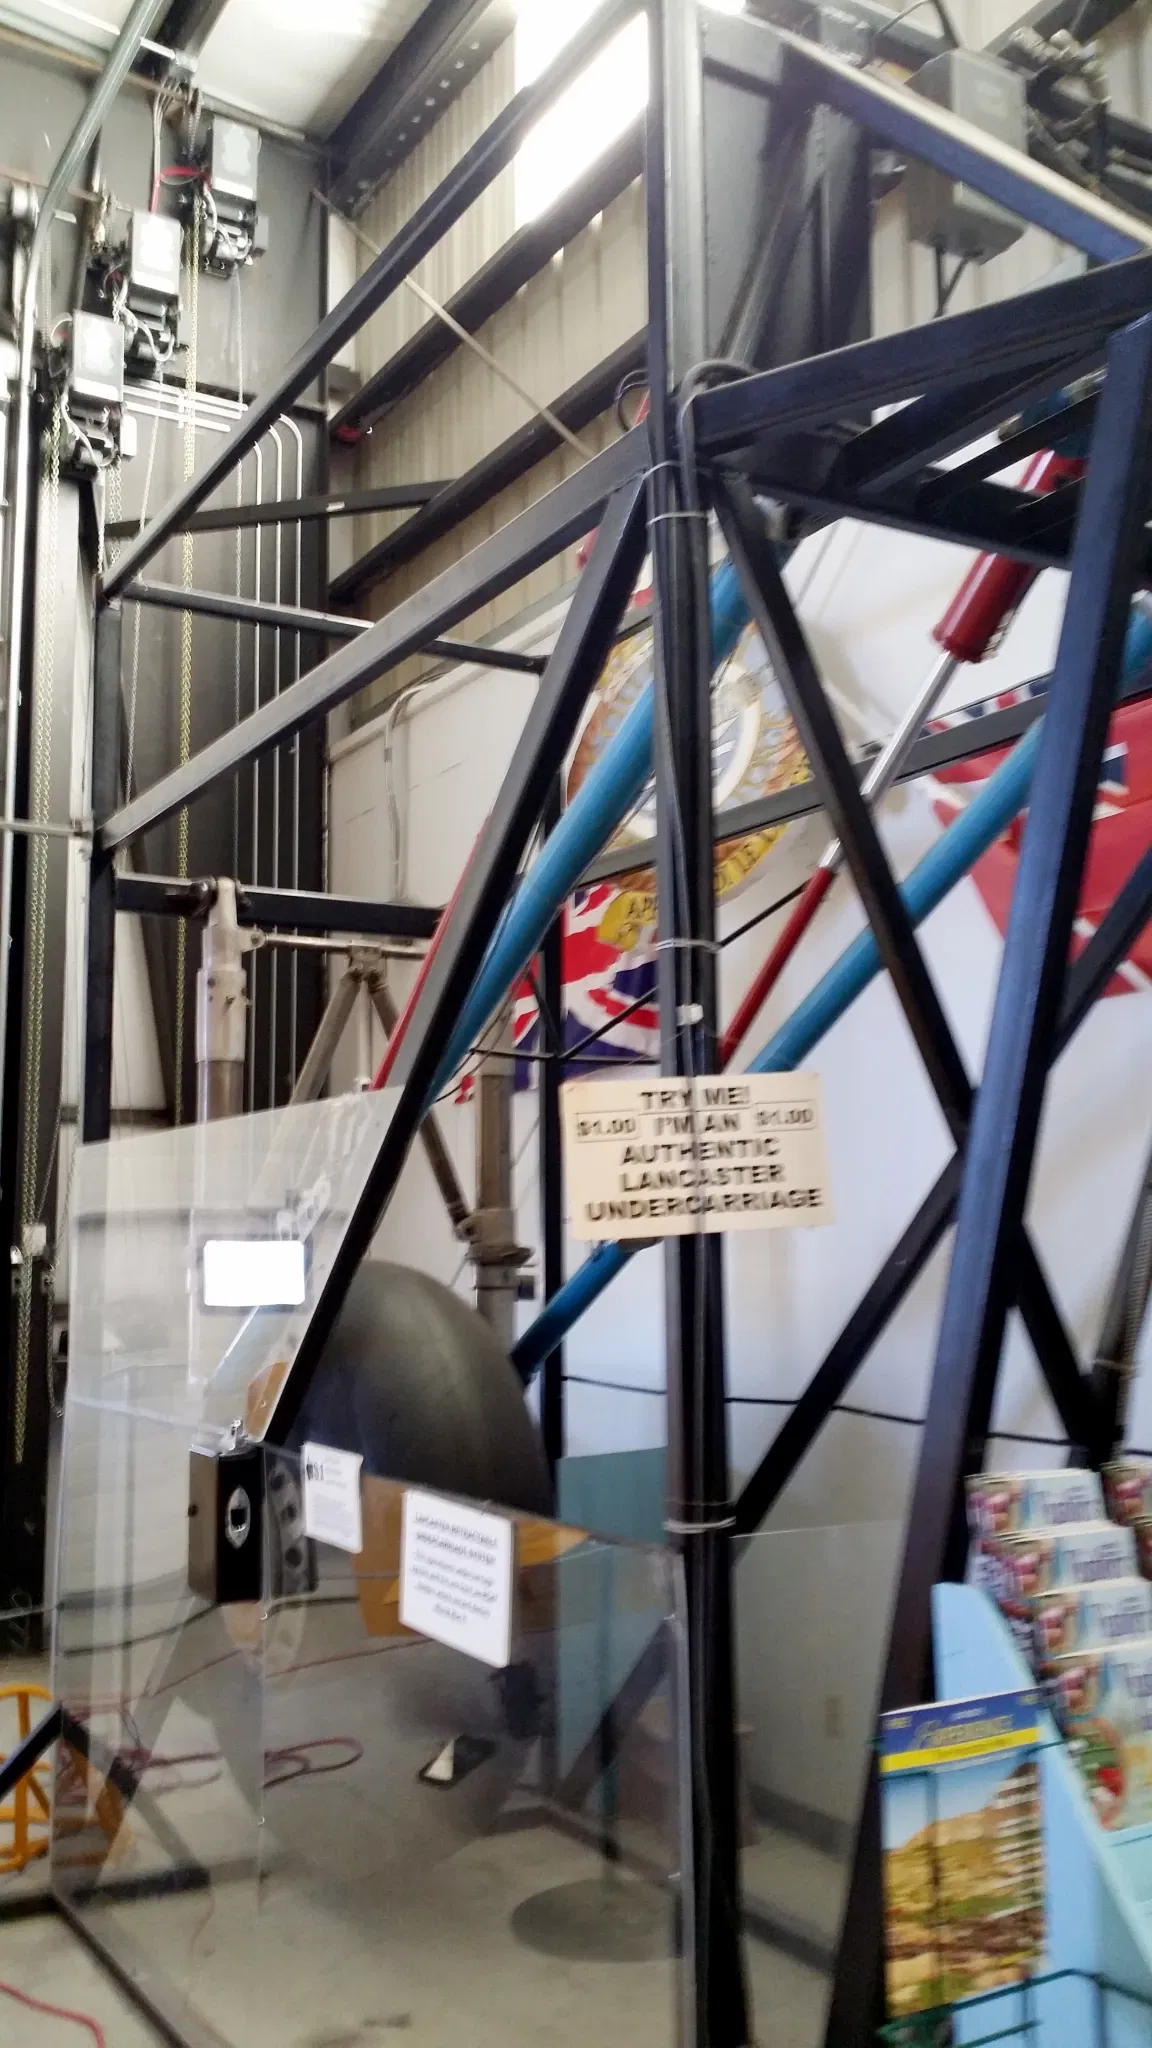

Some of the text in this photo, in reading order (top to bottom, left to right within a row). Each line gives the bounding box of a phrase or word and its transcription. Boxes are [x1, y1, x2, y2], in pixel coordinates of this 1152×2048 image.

[640, 1086, 751, 1110] TRY ME!
[576, 1118, 637, 1138] $1.00
[655, 1113, 741, 1136] I'M AN
[754, 1107, 814, 1127] $1.00
[621, 1137, 781, 1165] AUTHENTIC
[620, 1163, 786, 1193] LANCASTER
[586, 1187, 824, 1222] UNDERCARRIAGE
